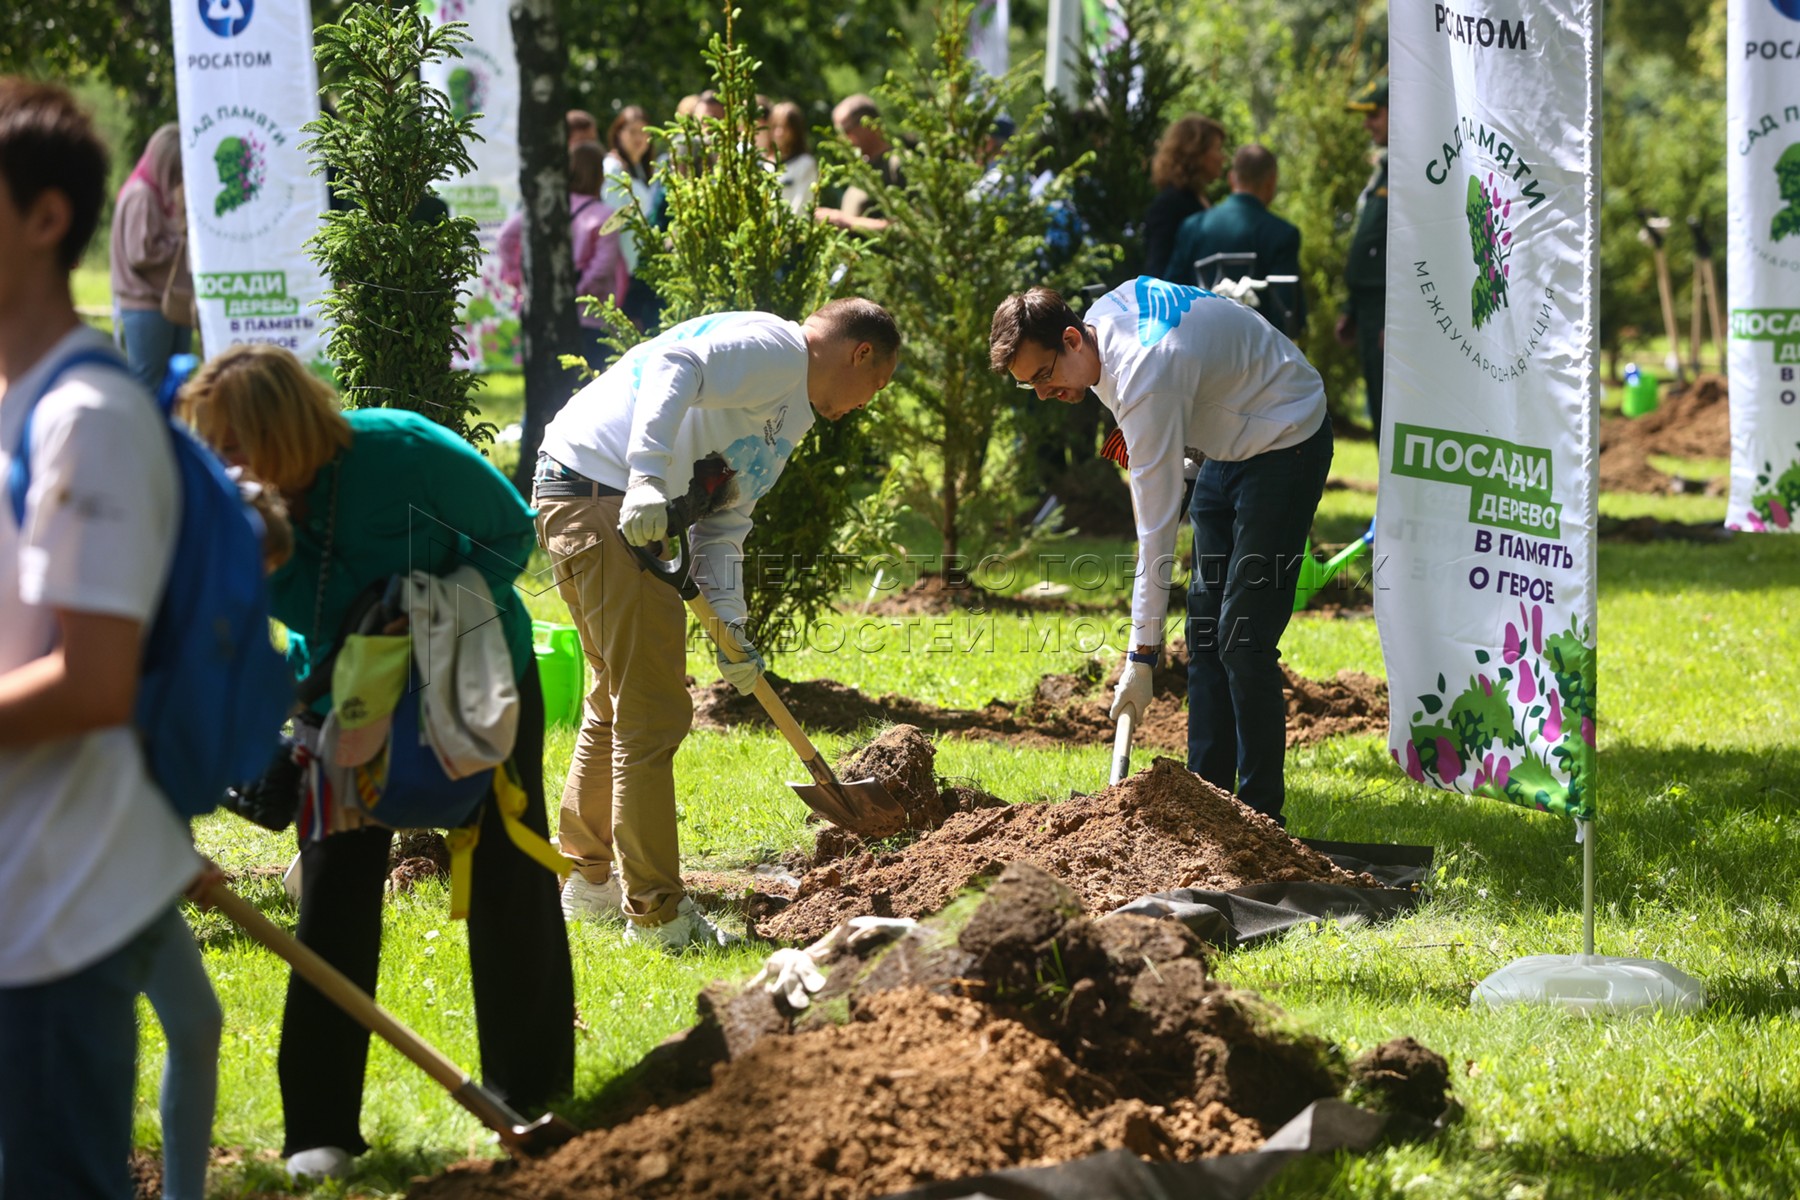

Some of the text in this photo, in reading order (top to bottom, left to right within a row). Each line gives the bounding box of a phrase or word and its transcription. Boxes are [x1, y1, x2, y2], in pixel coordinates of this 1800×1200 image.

[188, 51, 271, 70] РОСАТОМ
[1425, 124, 1463, 185] САД
[198, 274, 283, 297] ОСАДИ
[230, 319, 241, 332] В
[1781, 366, 1794, 382] В
[1780, 389, 1796, 405] О
[1403, 433, 1548, 492] ПОСАДИ
[1477, 493, 1556, 530] ДЕРЕВО
[1474, 529, 1493, 553] В
[1499, 534, 1573, 569] ПАМЯТЬ
[1469, 566, 1490, 590] О
[1496, 570, 1555, 604] ГЕРОЕ
